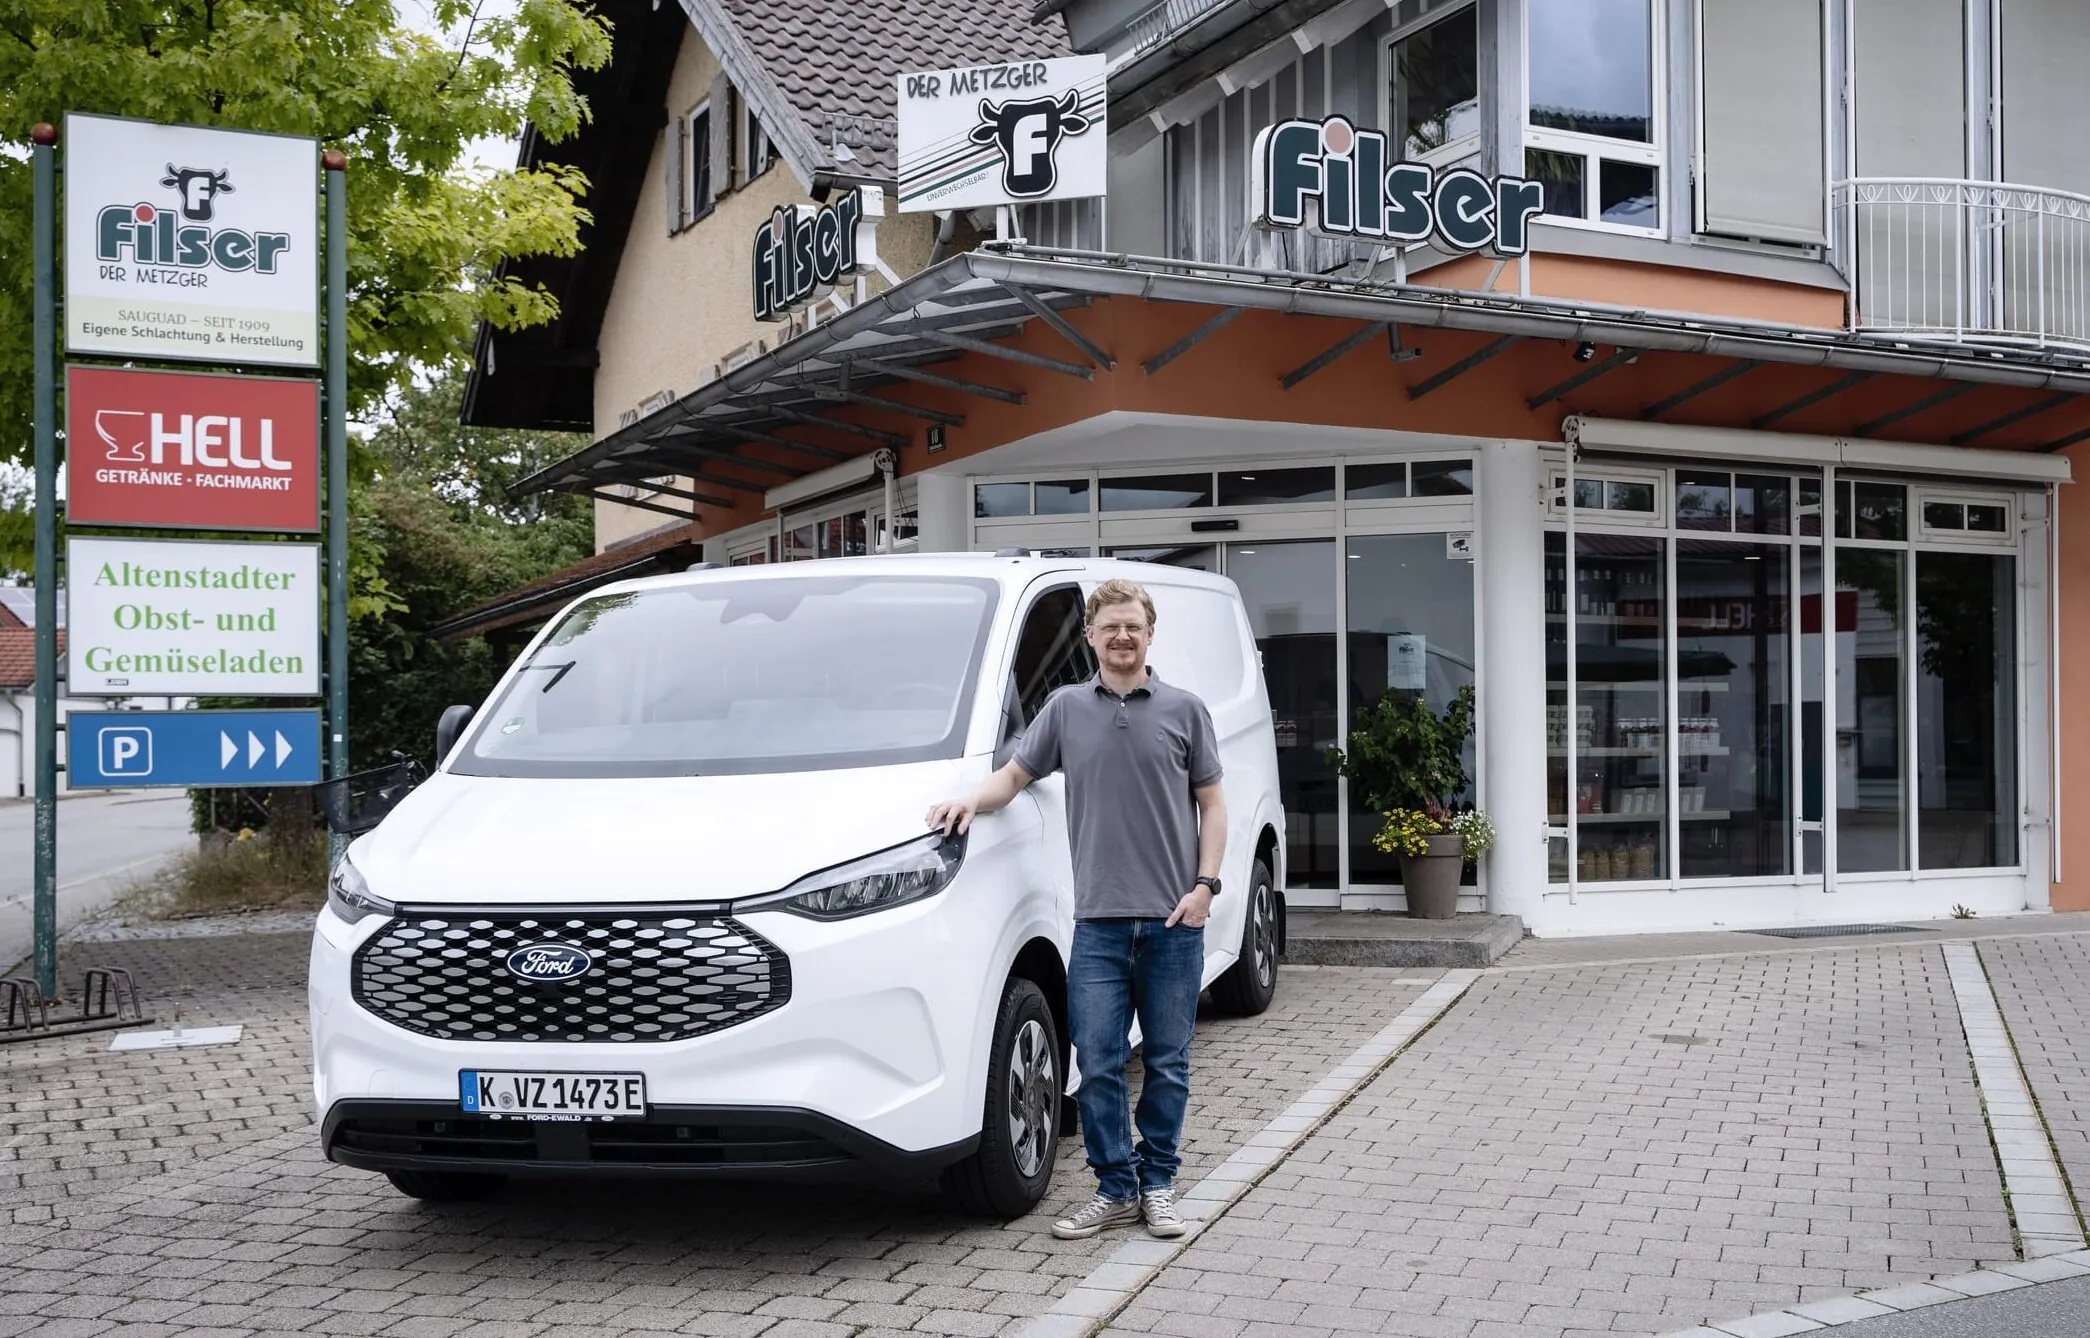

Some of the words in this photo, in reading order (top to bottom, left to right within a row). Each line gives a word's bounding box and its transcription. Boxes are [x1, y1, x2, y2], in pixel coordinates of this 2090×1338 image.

[906, 75, 941, 100] DER
[950, 62, 1048, 96] METZGER
[1264, 114, 1545, 255] Filser
[97, 202, 290, 274] Filser
[753, 185, 862, 321] Filser
[100, 265, 126, 282] DER
[136, 268, 208, 288] METZGER
[118, 309, 187, 325] SAUGUAD
[203, 316, 235, 329] SEIT
[238, 320, 270, 332] 1909
[82, 322, 128, 337] Eigene
[131, 325, 211, 345] Schlachtung
[215, 332, 226, 343] &
[230, 333, 304, 350] Herstellung
[151, 413, 292, 470] HELL
[95, 468, 183, 486] GETRÄNKE
[195, 474, 292, 491] FACHMARKT
[94, 562, 296, 590] Altenstadter
[113, 604, 205, 630] Obst-
[216, 608, 276, 632] und
[85, 646, 304, 674] Gemüseladen
[113, 736, 139, 769] P
[521, 949, 576, 974] Ford
[467, 1096, 474, 1105] D
[479, 1076, 496, 1107] K
